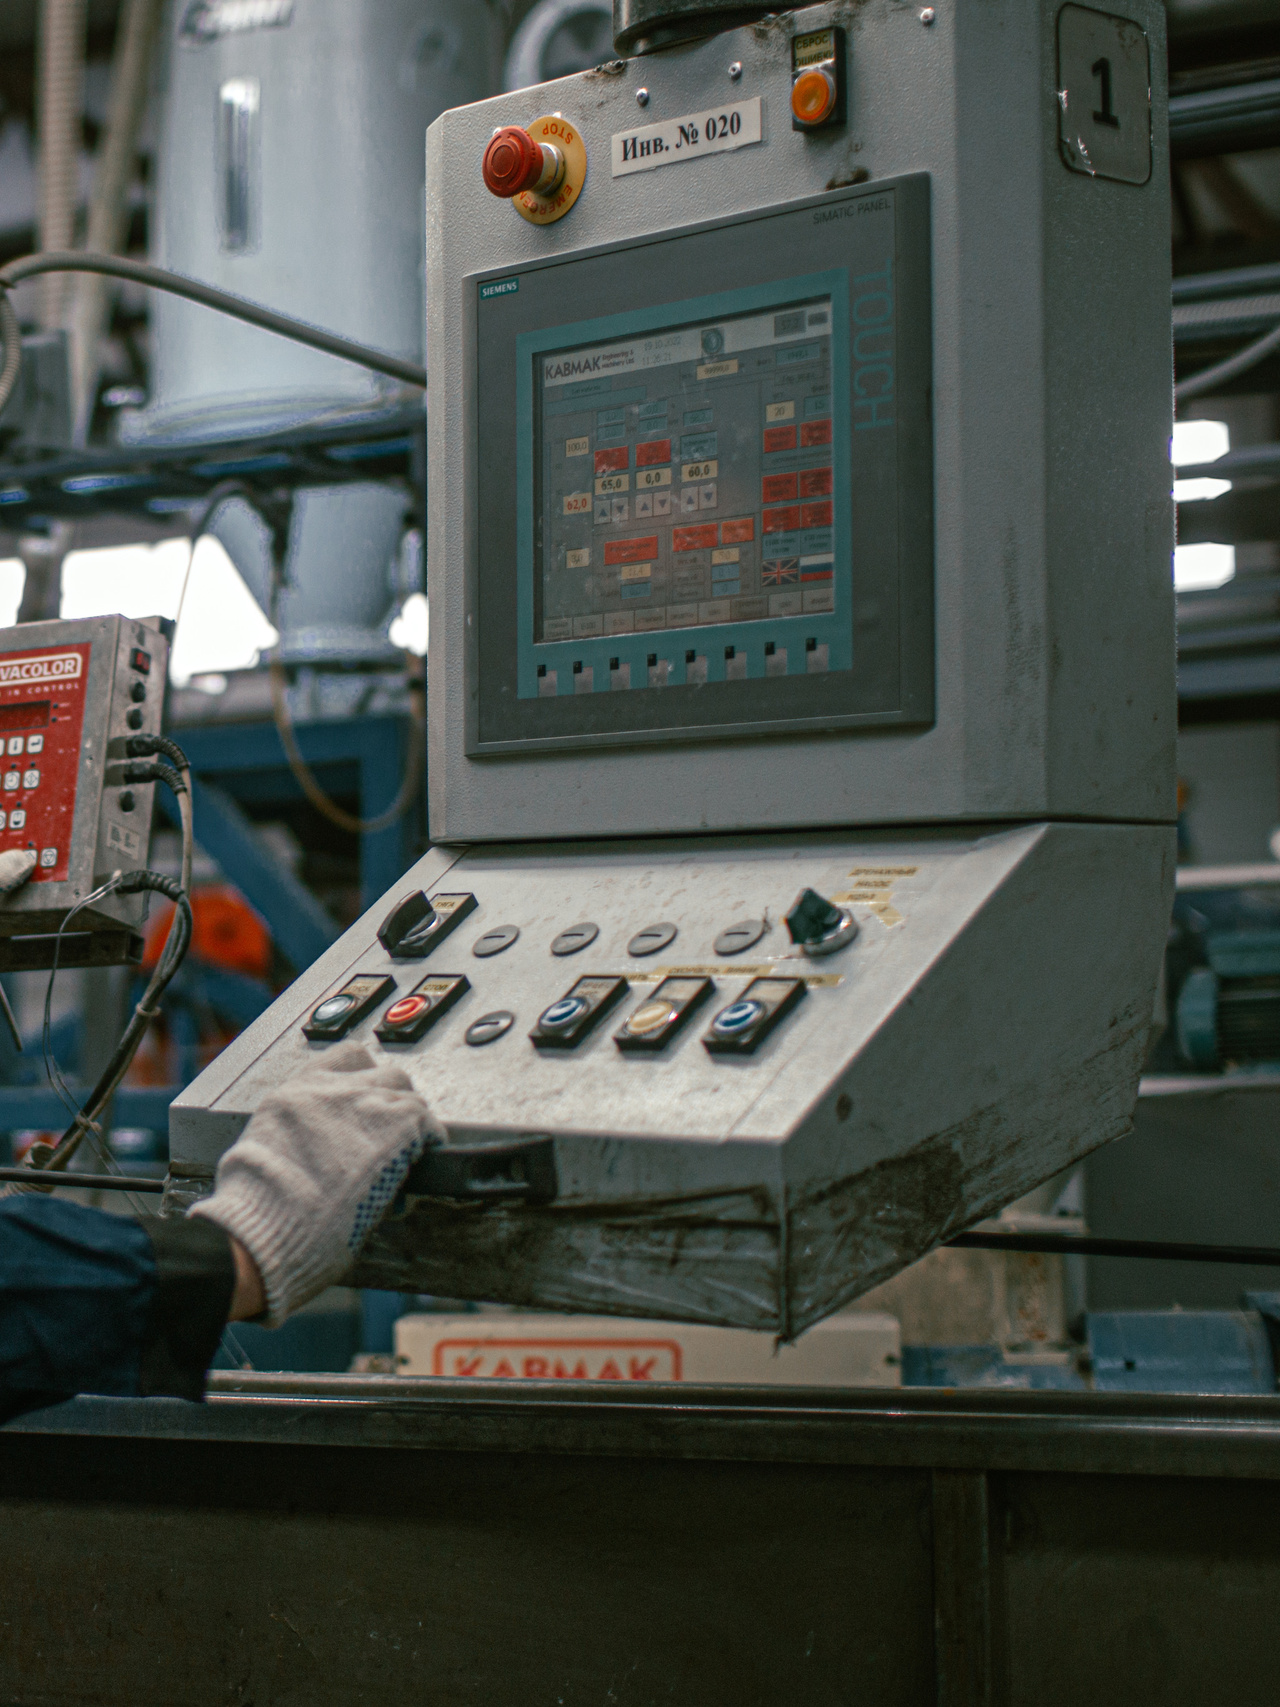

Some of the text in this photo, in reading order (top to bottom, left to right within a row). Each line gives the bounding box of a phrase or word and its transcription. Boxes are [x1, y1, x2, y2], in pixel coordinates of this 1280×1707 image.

[796, 34, 828, 50] СБРОС
[1091, 57, 1120, 130] 1
[542, 123, 573, 144] STOP
[621, 111, 741, 162] Инв. № 020
[519, 184, 573, 215] EMERGEN
[813, 198, 891, 225] SIMATIC PANEL
[482, 281, 517, 297] SIEMENS
[852, 257, 895, 431] TOUCH
[545, 356, 601, 380] KABMAK
[567, 442, 587, 453] 100,0
[645, 472, 661, 485] 0,0
[688, 465, 710, 478] 60,0
[601, 478, 622, 491] 65,0
[567, 498, 587, 511] 62,0
[27, 683, 79, 694] CONTROL
